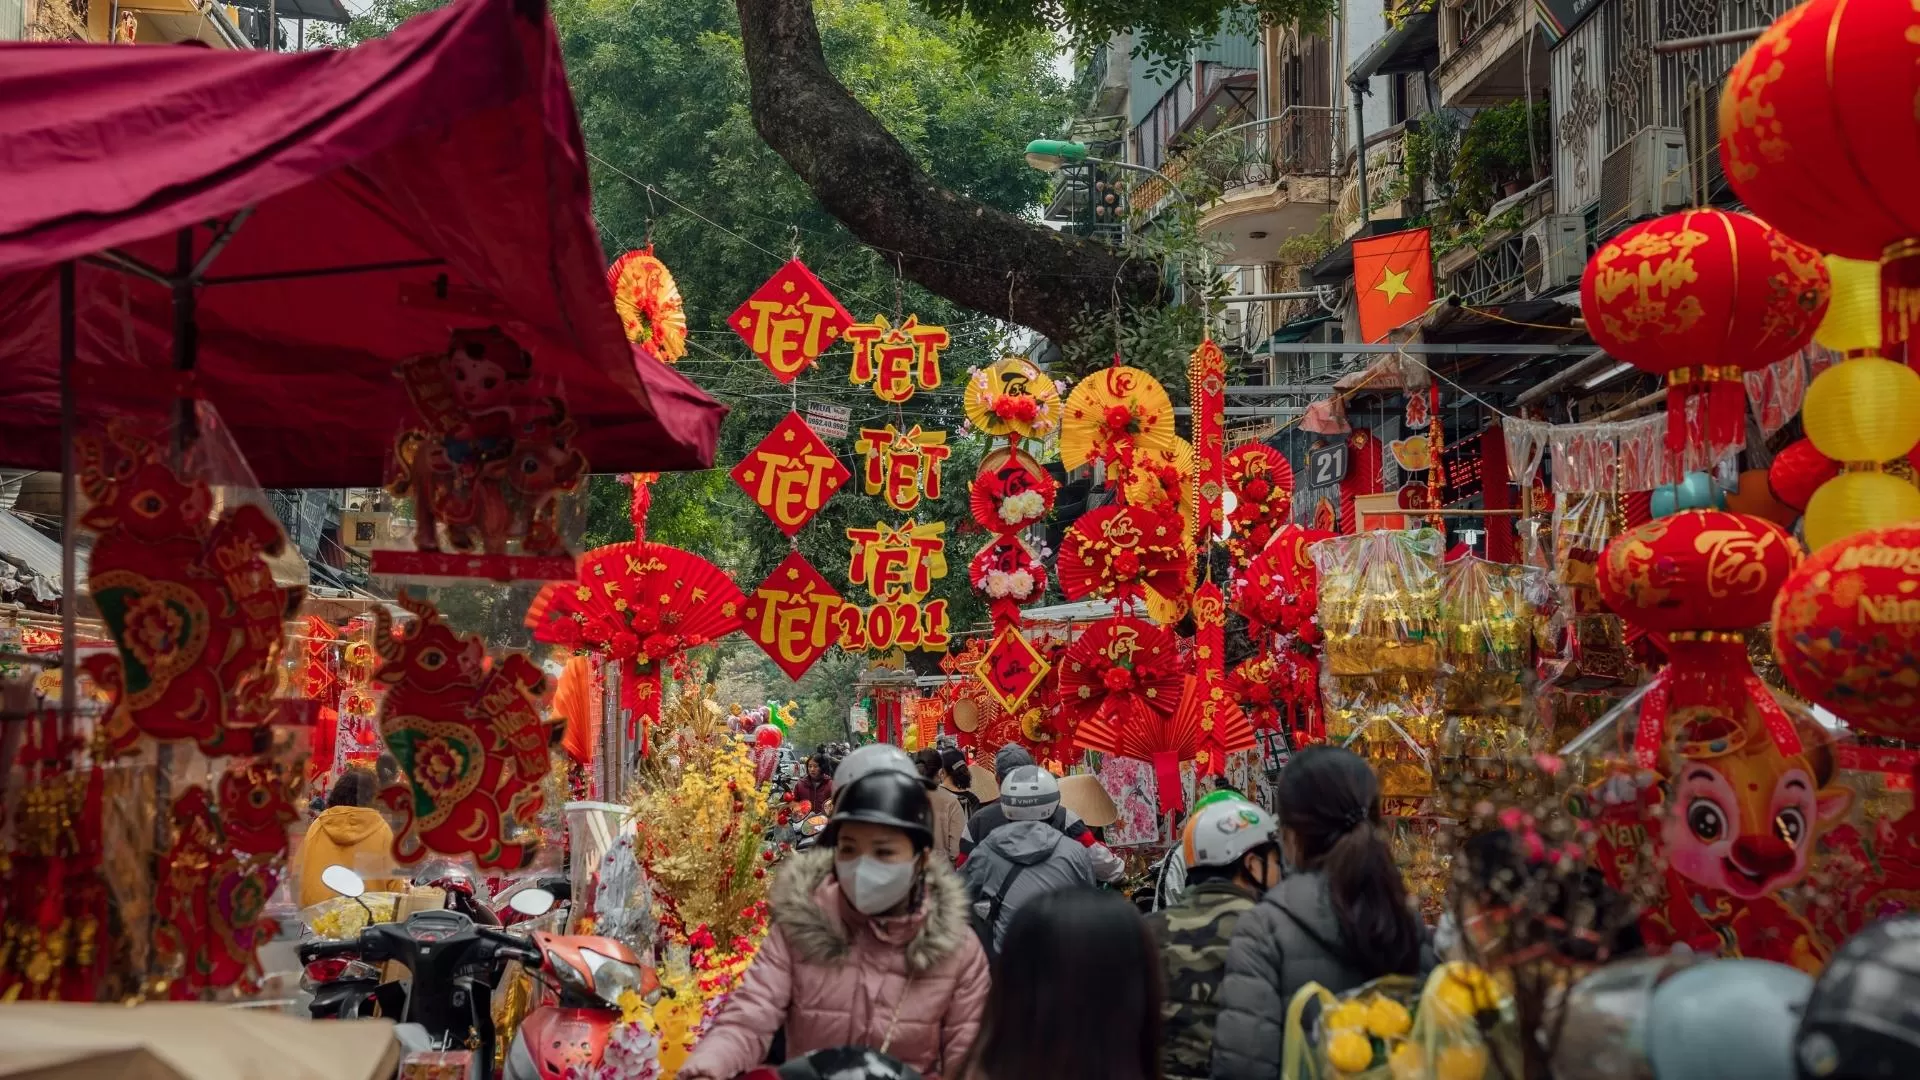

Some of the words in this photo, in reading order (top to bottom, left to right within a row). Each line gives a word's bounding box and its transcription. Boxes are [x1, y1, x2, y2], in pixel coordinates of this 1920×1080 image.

[750, 291, 835, 373] TẾT
[847, 313, 949, 401] TẾT
[757, 442, 835, 525] TẾT
[859, 424, 951, 511] TẾT
[1317, 449, 1342, 483] 21
[625, 554, 667, 576] Xuân
[847, 518, 944, 603] TẾT
[758, 580, 841, 662] TẾT
[838, 600, 950, 650] 2021
